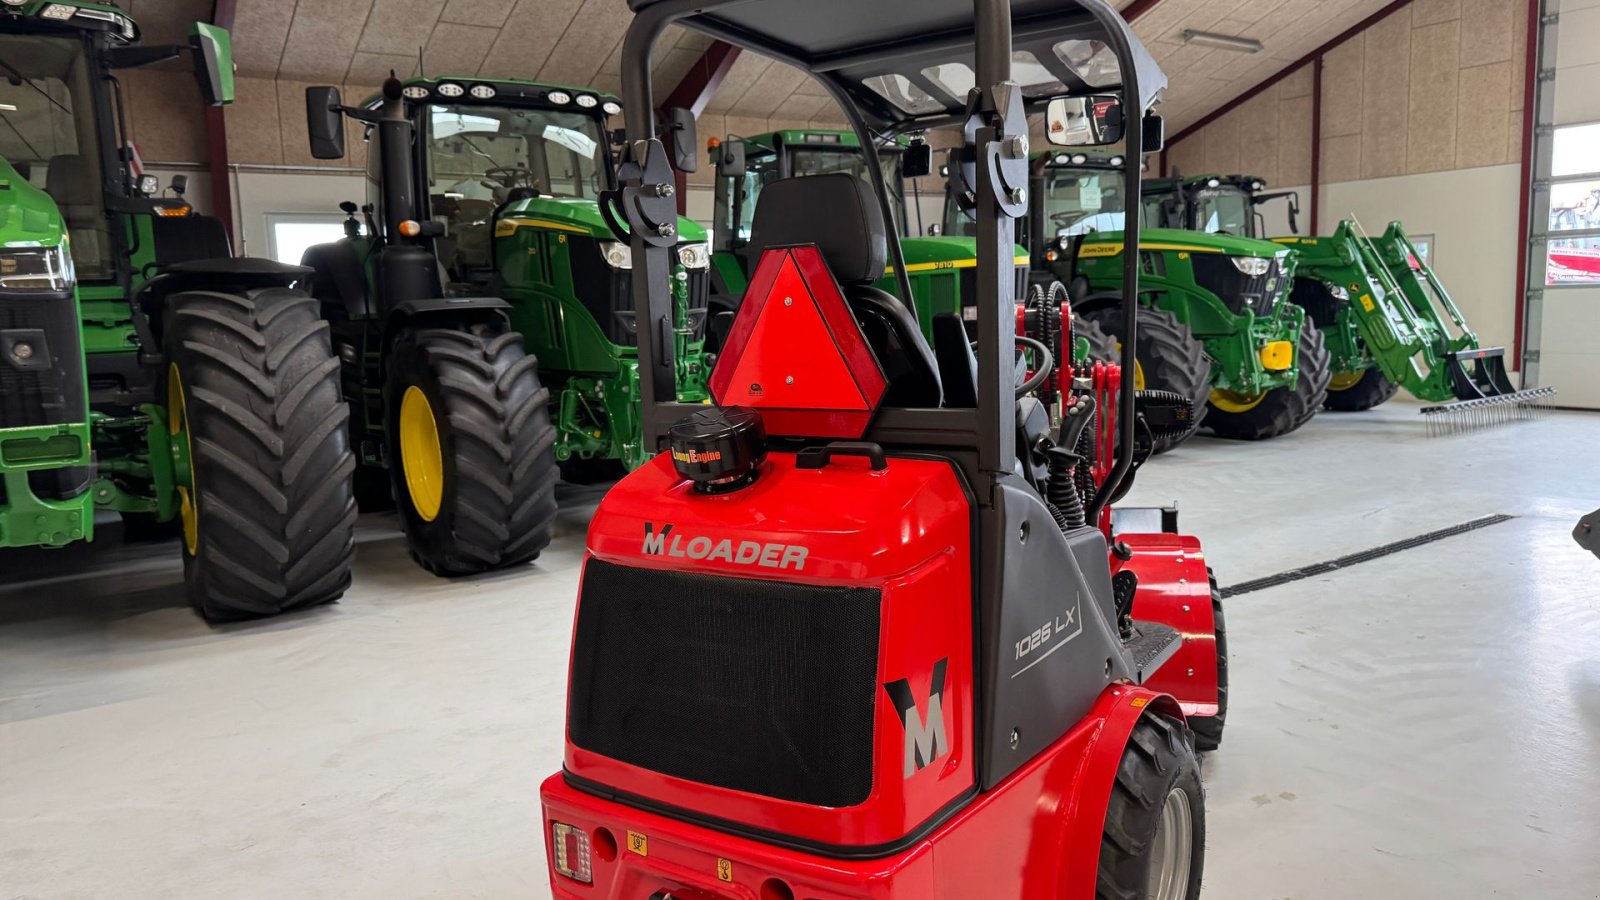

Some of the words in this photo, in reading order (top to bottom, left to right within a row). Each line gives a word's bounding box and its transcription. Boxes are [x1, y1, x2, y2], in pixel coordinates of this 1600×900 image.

[668, 534, 809, 570] LOADER
[1015, 621, 1052, 661] 1026
[1055, 606, 1076, 634] LX
